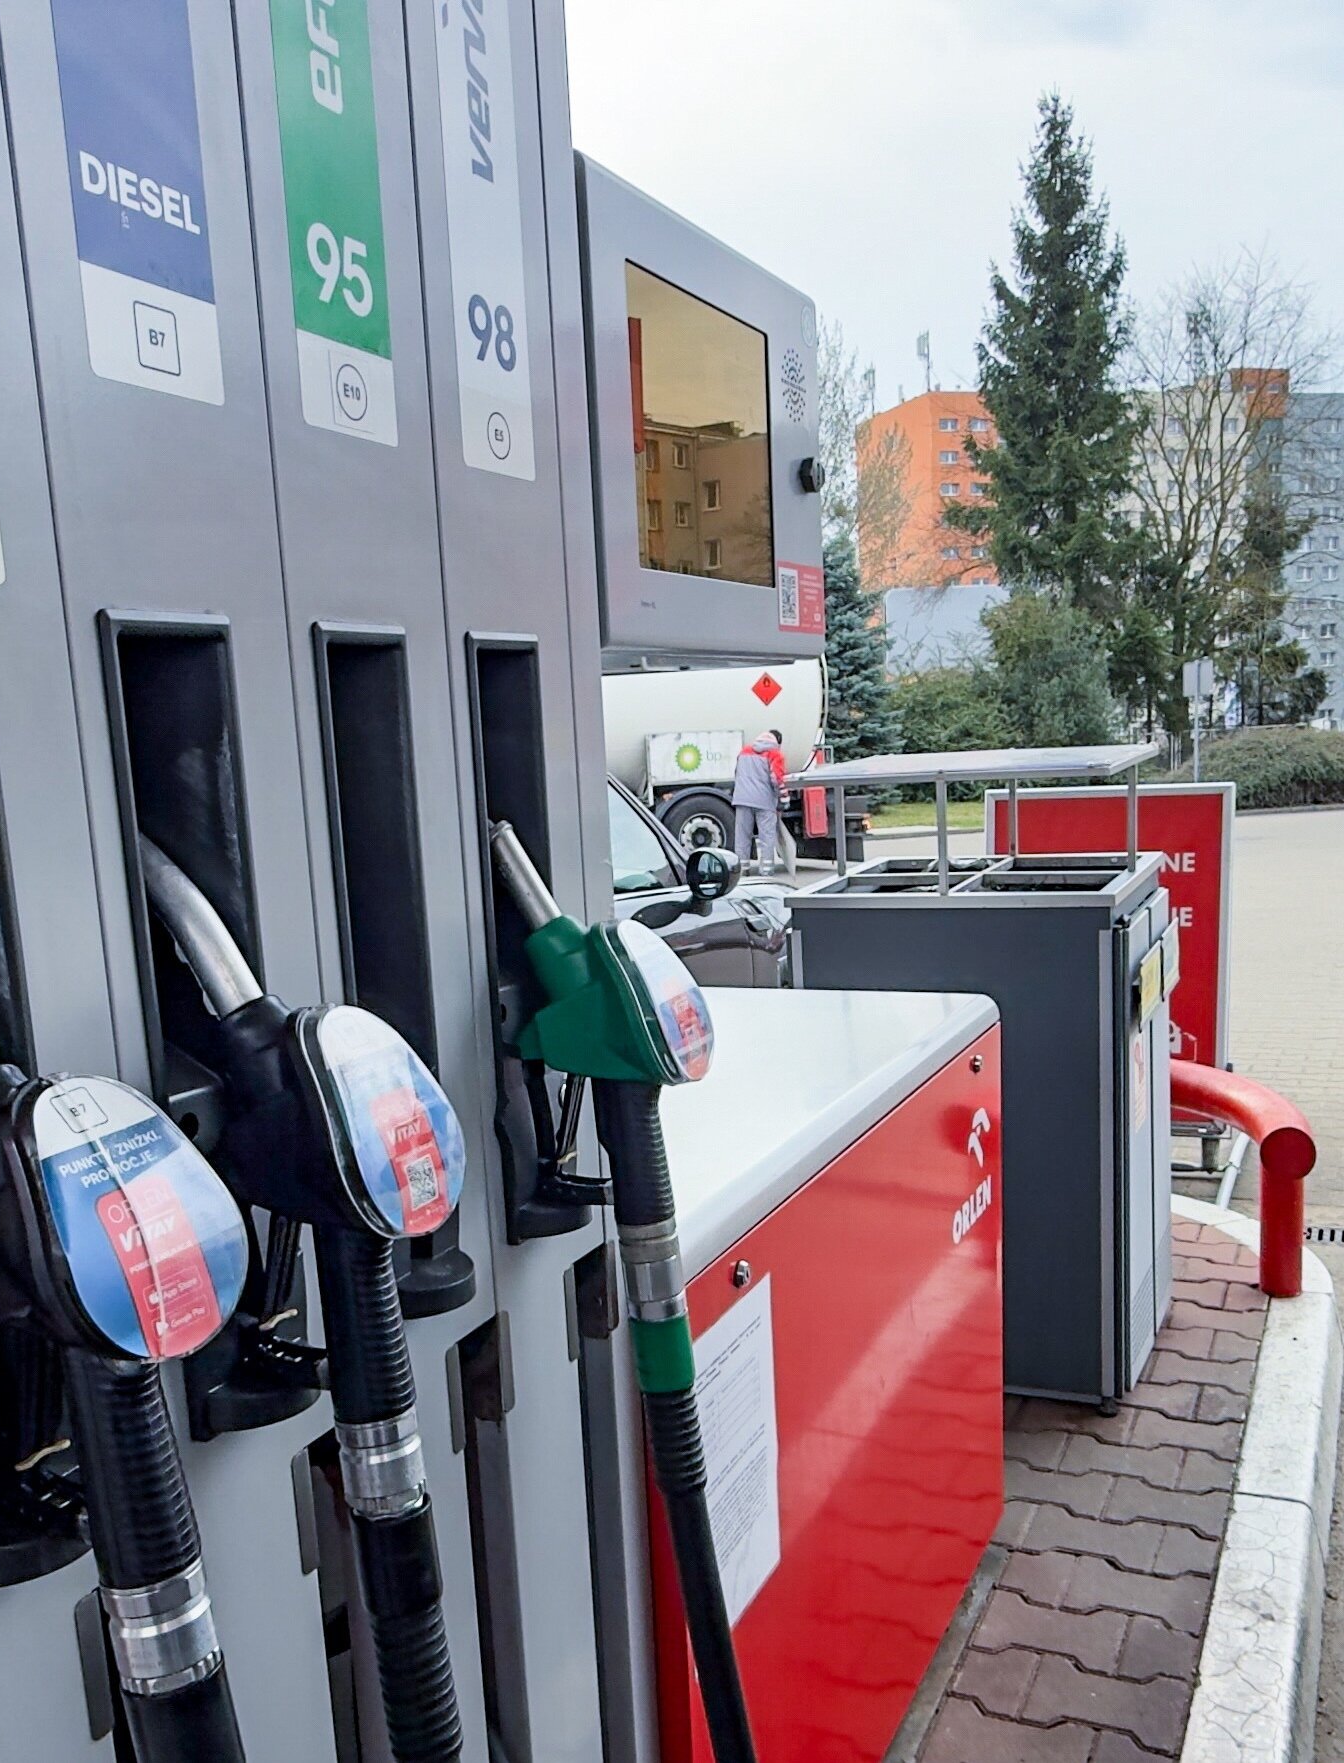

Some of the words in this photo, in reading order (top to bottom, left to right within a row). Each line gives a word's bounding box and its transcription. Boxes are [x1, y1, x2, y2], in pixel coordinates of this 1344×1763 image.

[79, 150, 200, 235] DIESEL
[306, 222, 374, 318] 95
[149, 328, 166, 348] B7
[468, 294, 517, 372] 98
[343, 382, 361, 401] E10
[706, 749, 722, 764] bp
[69, 1103, 87, 1117] B7
[952, 1174, 993, 1244] ORLEN
